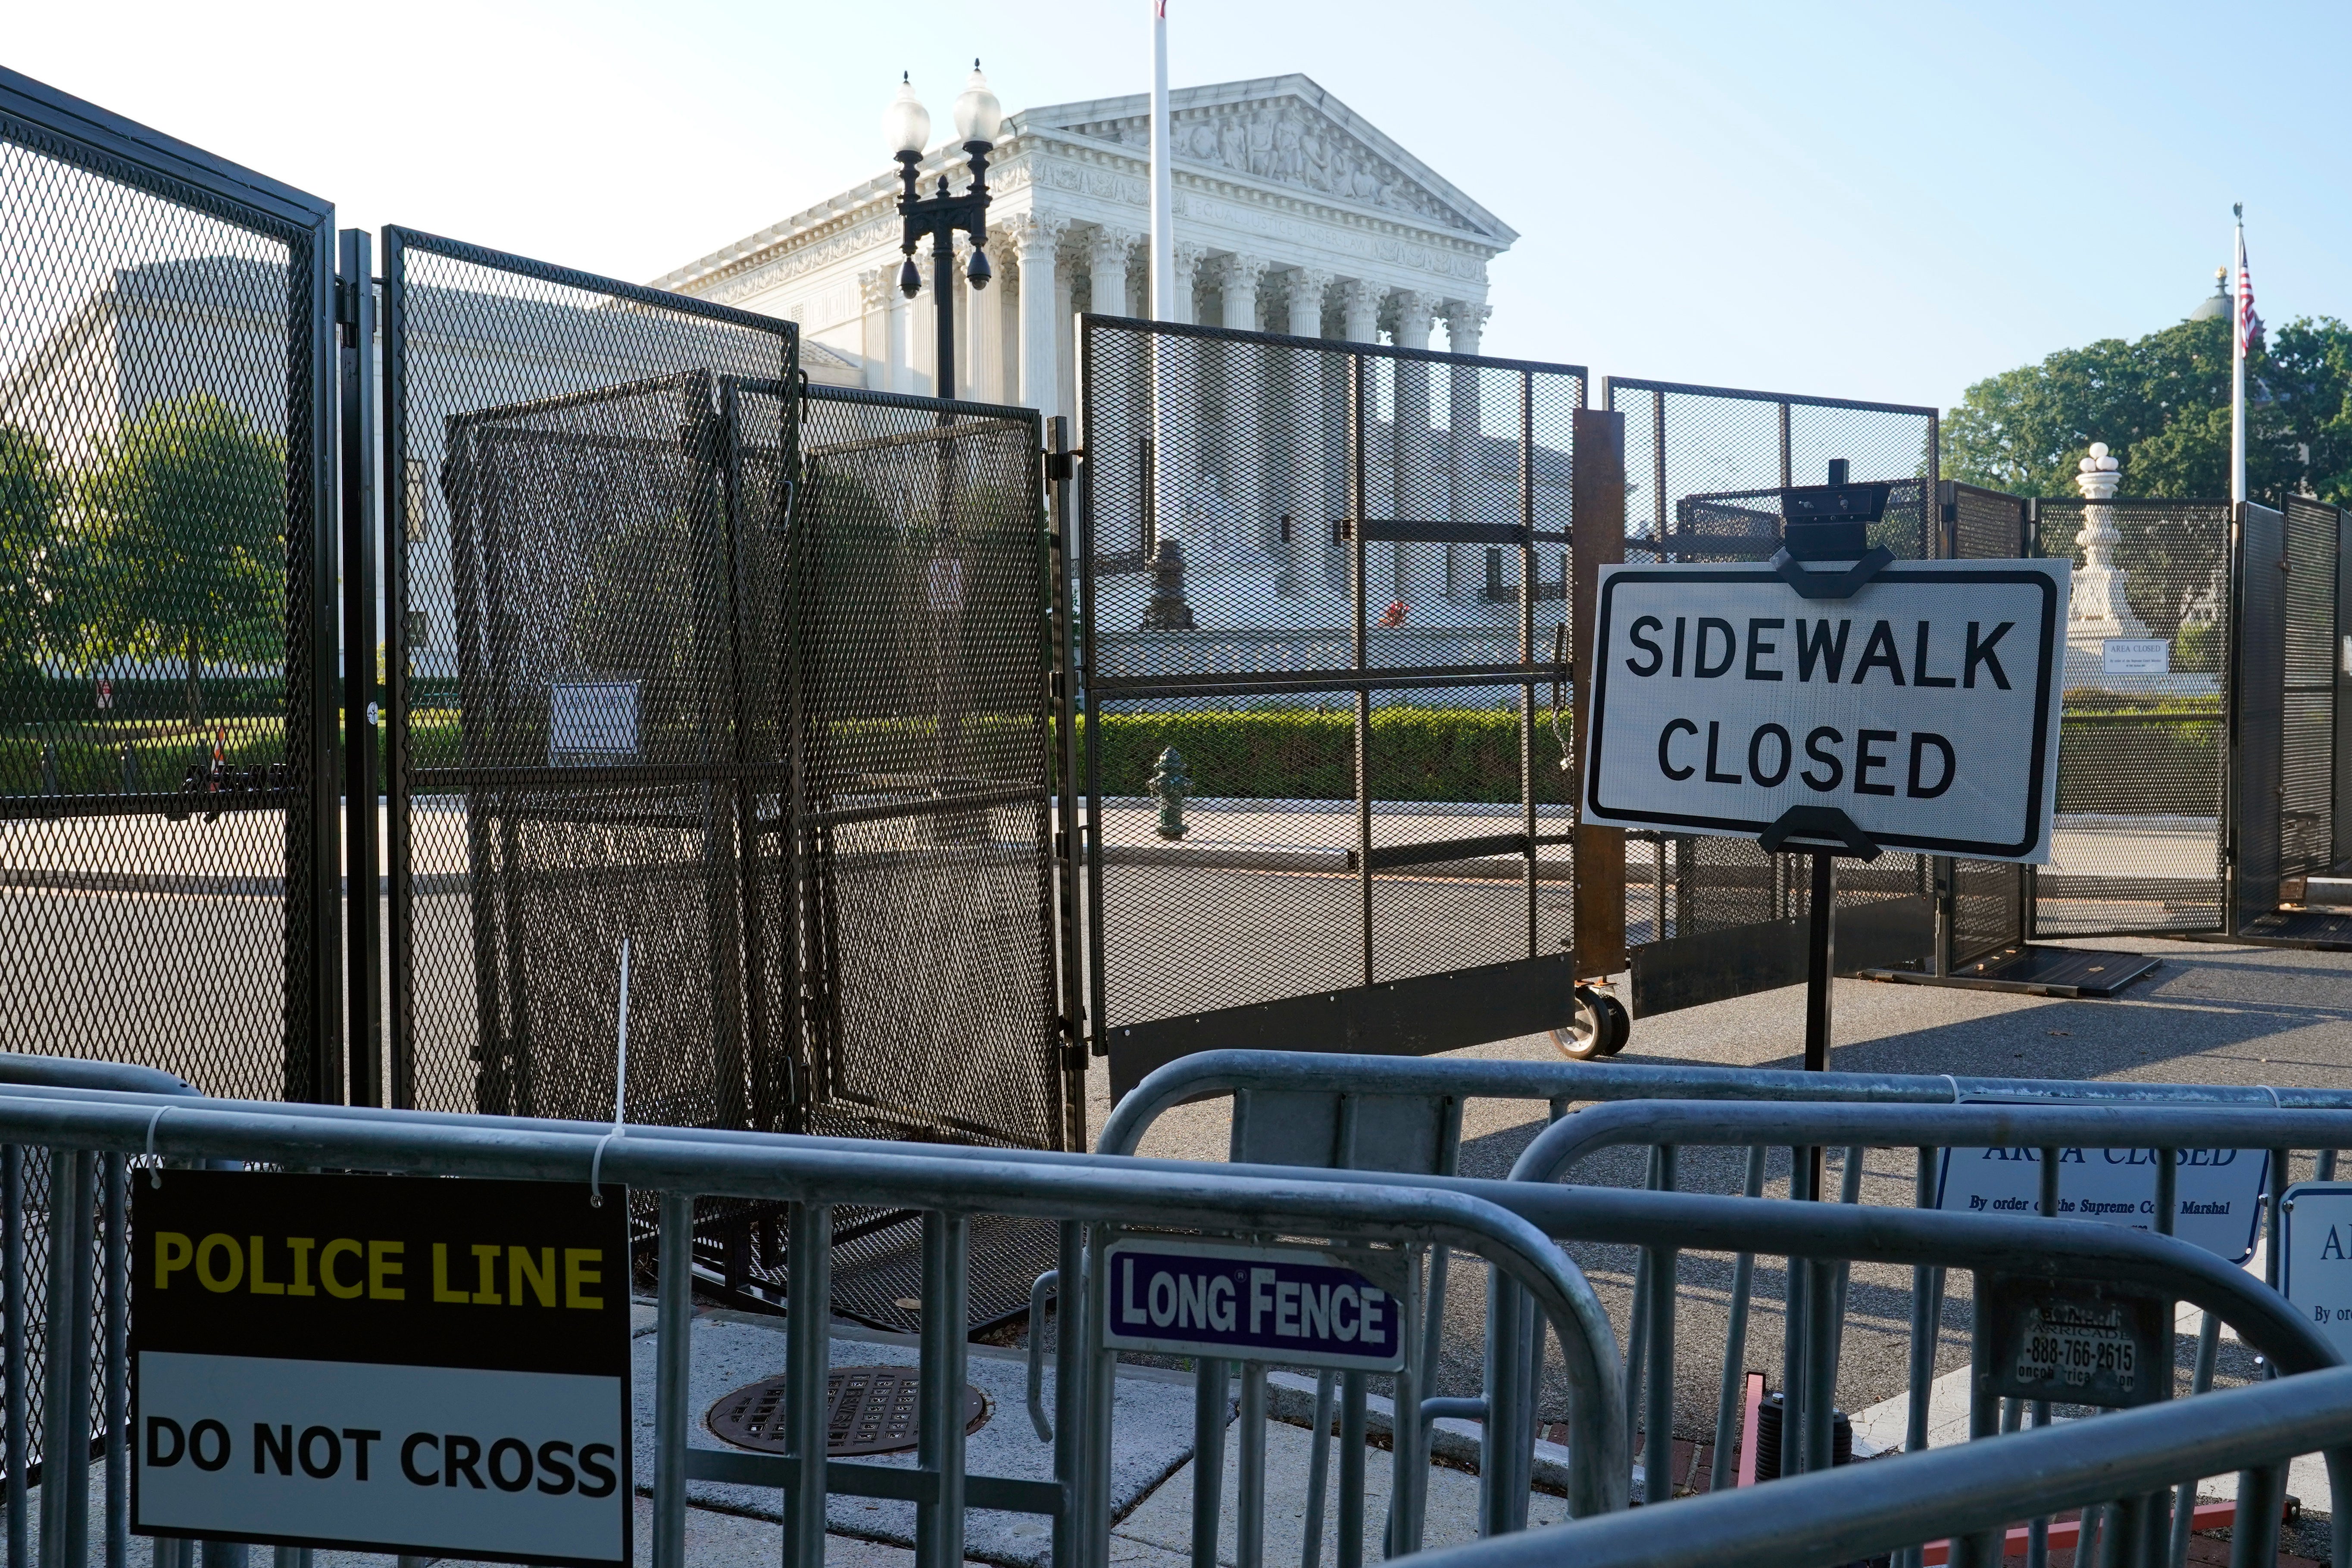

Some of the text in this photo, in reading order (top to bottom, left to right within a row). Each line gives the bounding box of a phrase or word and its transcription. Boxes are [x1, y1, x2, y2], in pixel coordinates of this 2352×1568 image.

[1195, 201, 1367, 251] EQUAL JUSTICE UNDER LAW
[1625, 615, 2016, 690] SIDEWALK
[1658, 718, 1956, 799] CLOSED
[1969, 1195, 1988, 1211] By
[1993, 1197, 2029, 1210] order
[2080, 1199, 2135, 1215] Supreme
[2180, 1201, 2230, 1215] Marshal
[154, 1231, 604, 1310] POLICE LINE
[1250, 1267, 1386, 1344] FENCE
[2314, 1306, 2330, 1324] By
[146, 1416, 617, 1499] DO NOT CROSS
